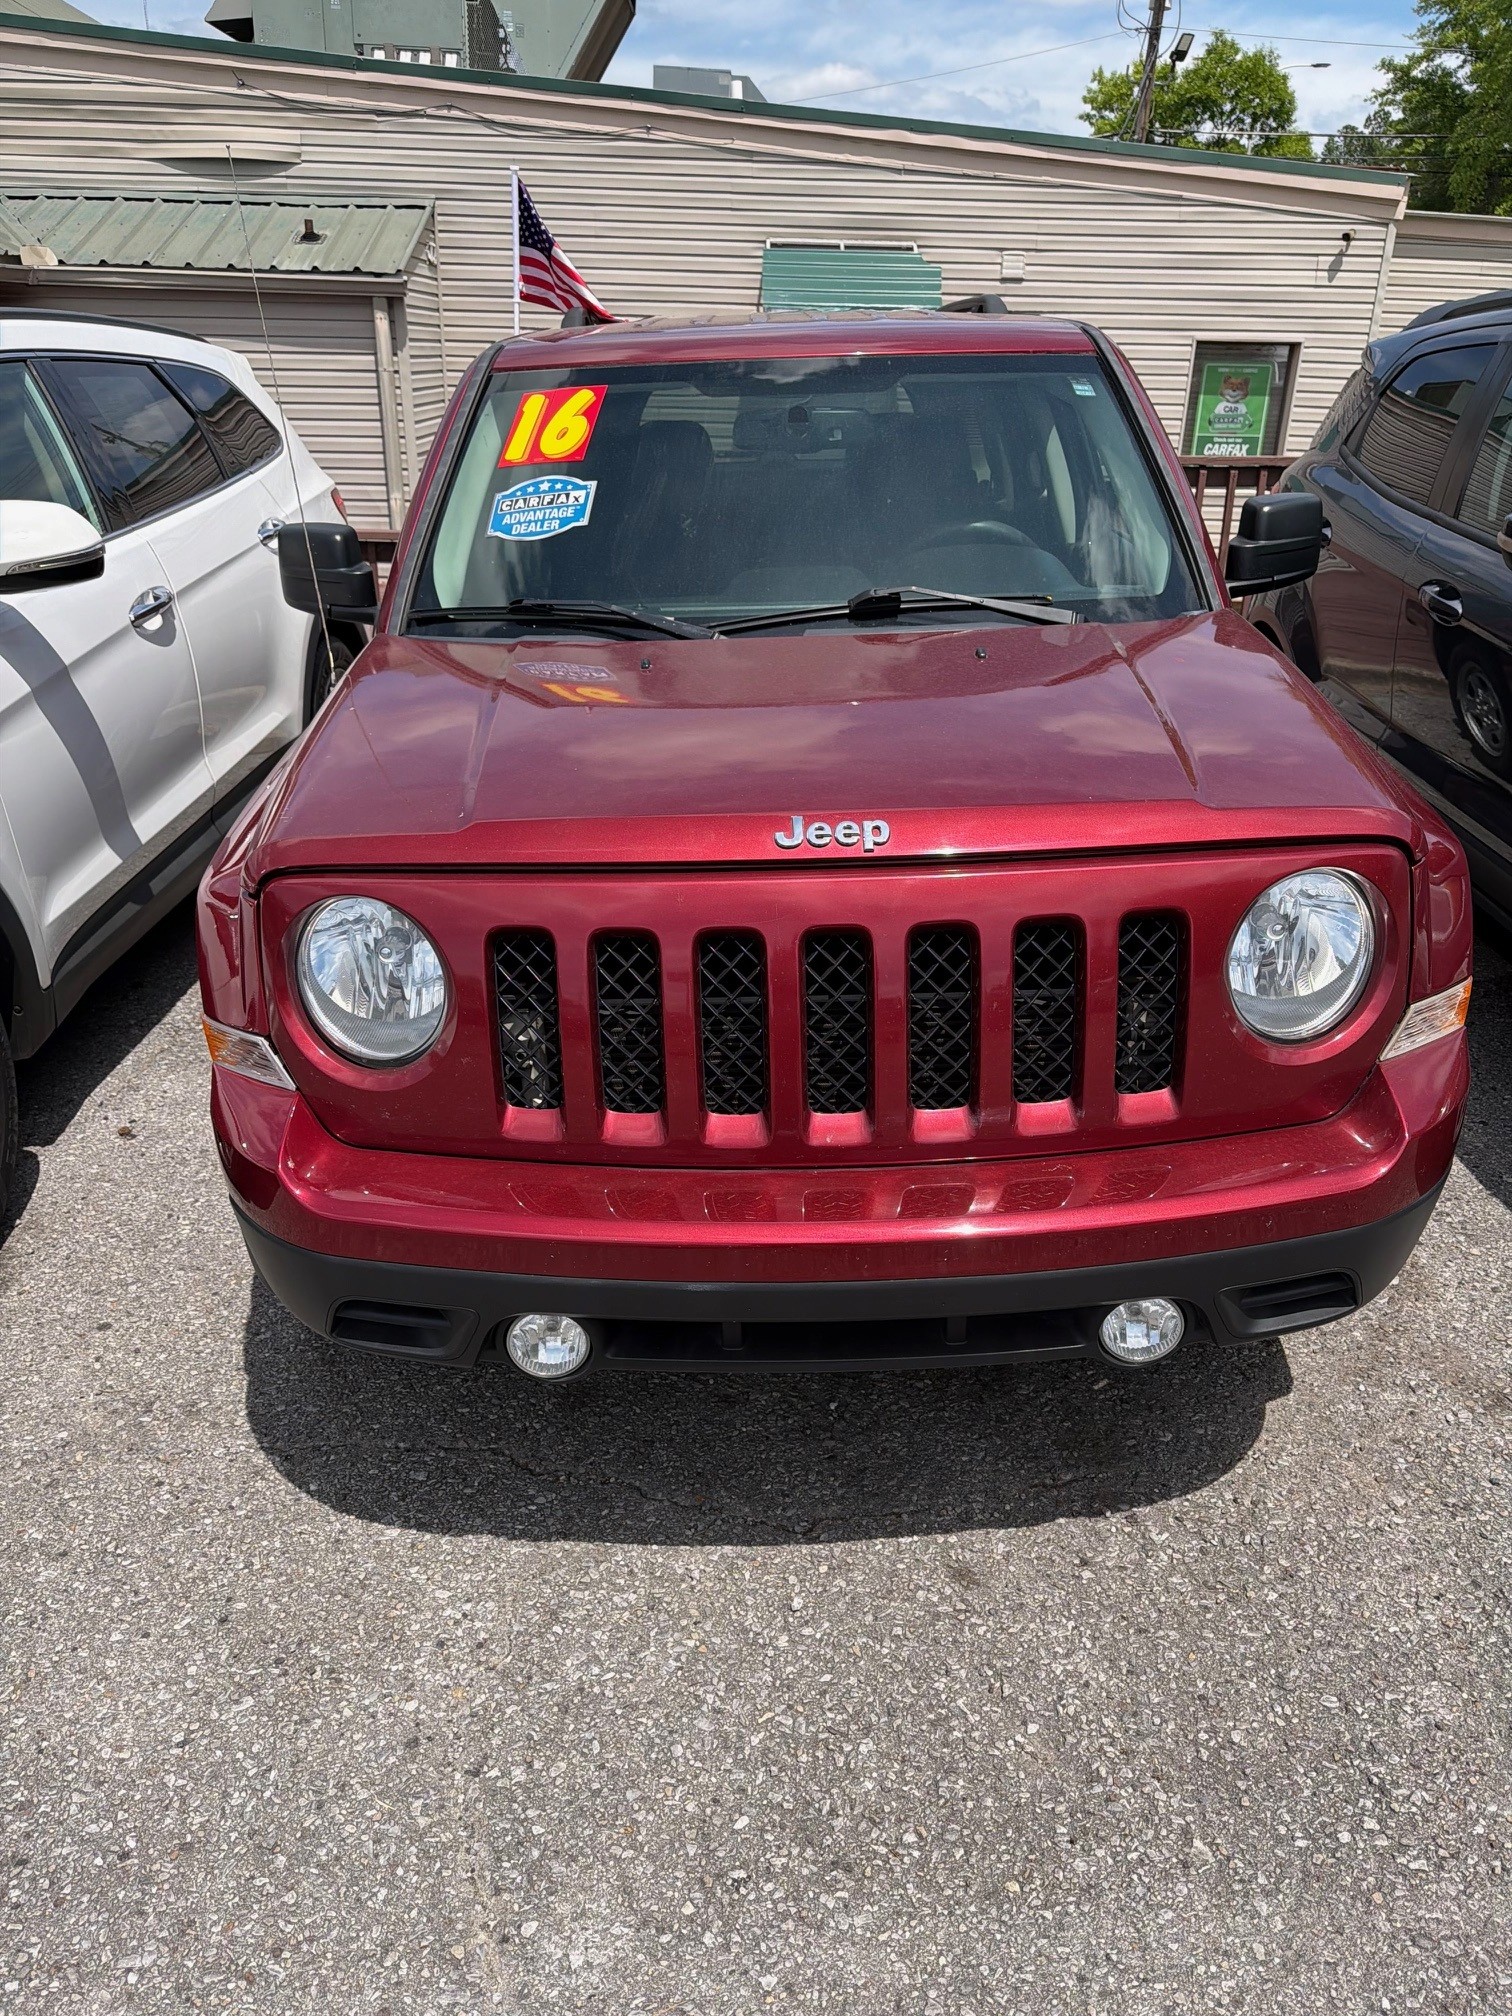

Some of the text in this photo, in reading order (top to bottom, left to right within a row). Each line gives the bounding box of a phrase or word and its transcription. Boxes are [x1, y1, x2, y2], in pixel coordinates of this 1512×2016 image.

[1223, 405, 1239, 413] CAR
[504, 388, 597, 463] 16
[1203, 443, 1249, 456] CARFAX
[500, 492, 583, 512] CARFAX
[502, 506, 575, 525] ADVANTAGE
[511, 520, 560, 535] DEALER
[774, 815, 891, 852] Jeep
